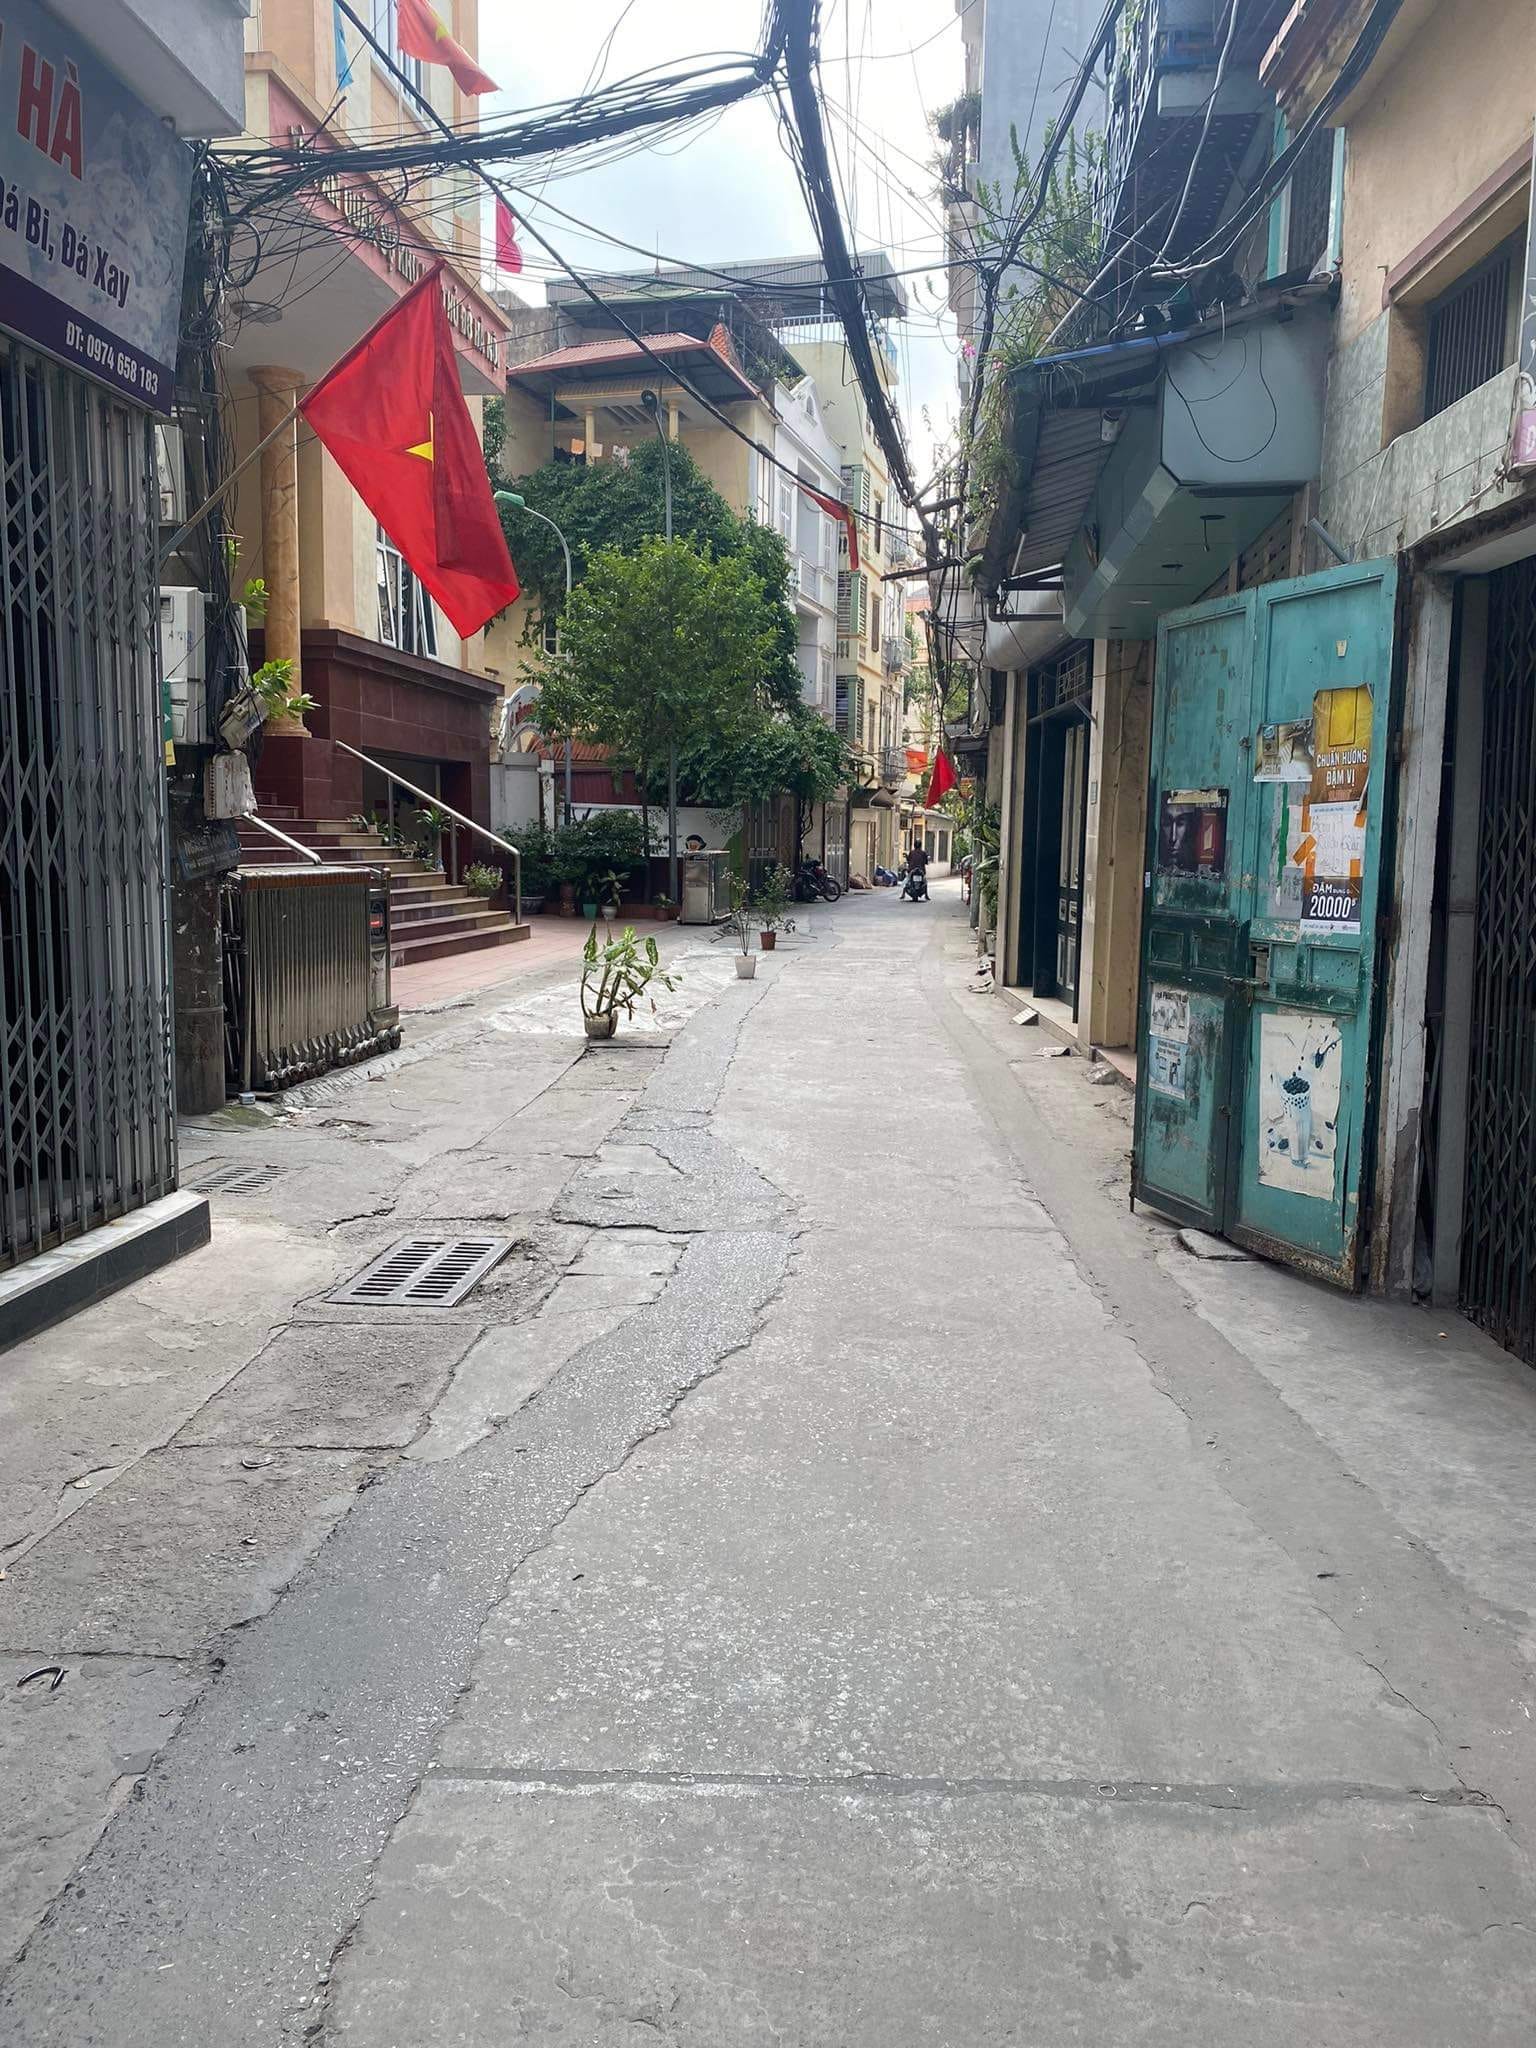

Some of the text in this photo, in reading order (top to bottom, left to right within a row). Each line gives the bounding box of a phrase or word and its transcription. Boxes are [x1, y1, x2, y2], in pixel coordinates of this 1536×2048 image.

[16, 42, 83, 181] HÀ
[25, 196, 53, 261] Bi,
[61, 222, 88, 278] Đá
[93, 245, 129, 308] Xay
[66, 320, 158, 395] ĐT: 0974 658 183
[1316, 747, 1340, 767] CHUẨN
[1326, 767, 1355, 788] ĐẬM VỊ
